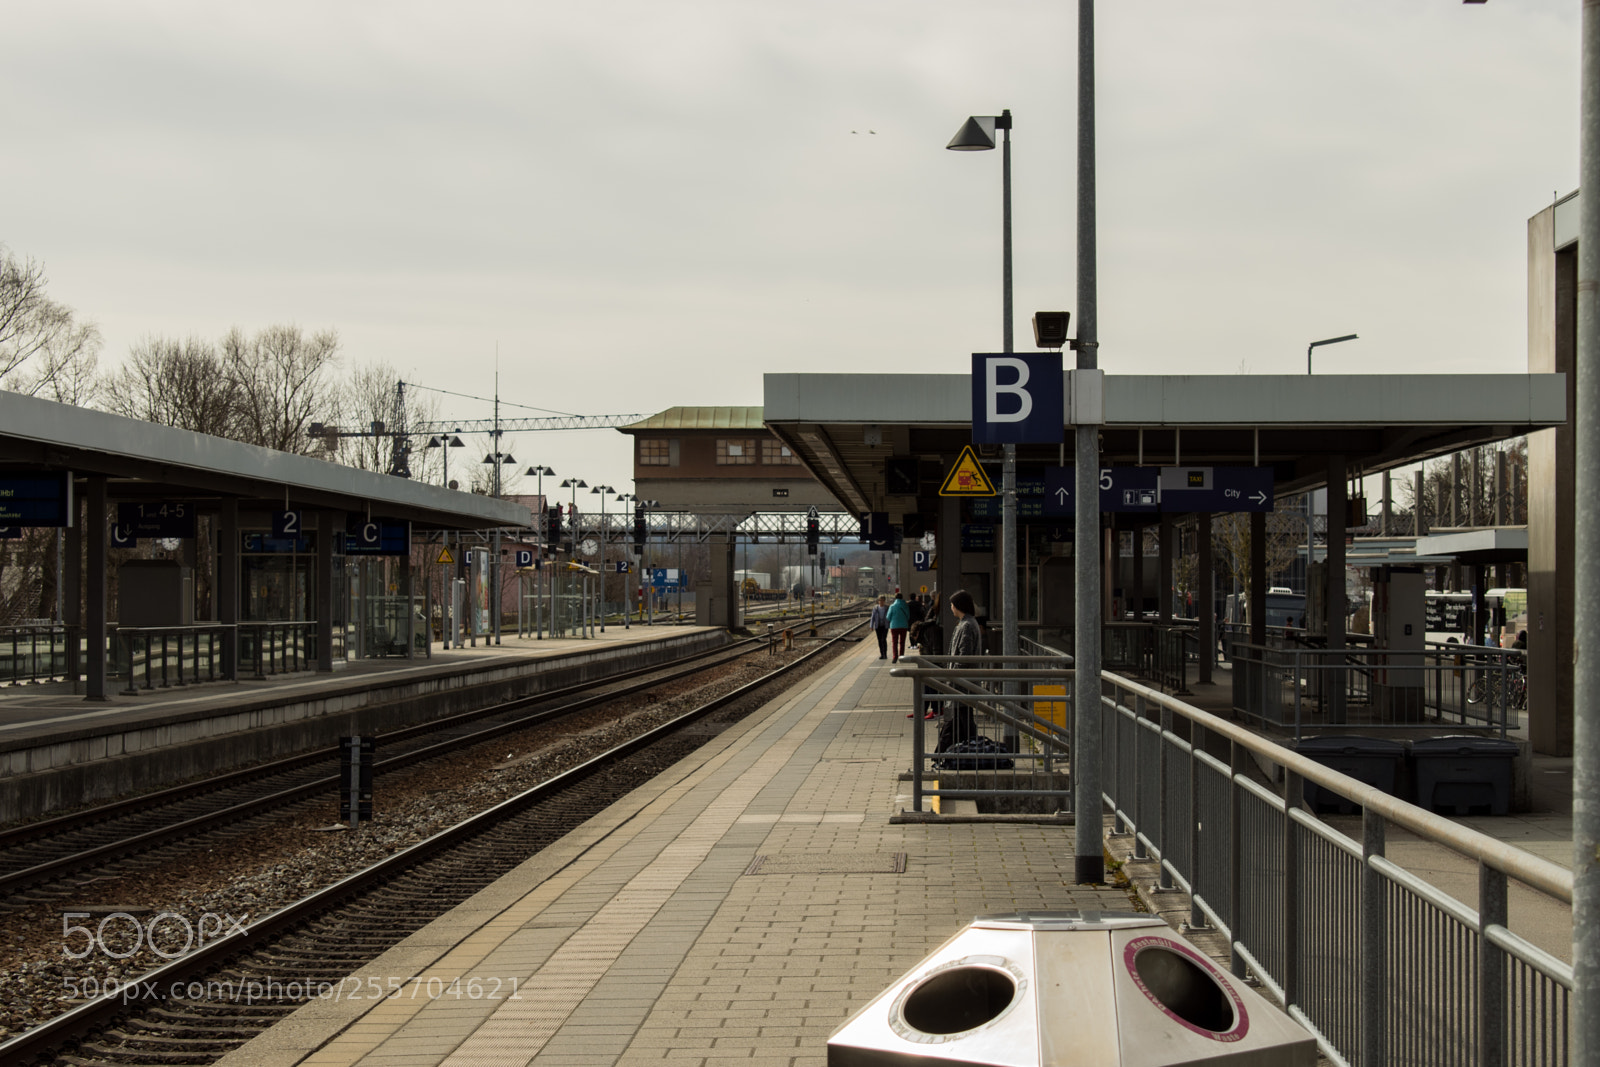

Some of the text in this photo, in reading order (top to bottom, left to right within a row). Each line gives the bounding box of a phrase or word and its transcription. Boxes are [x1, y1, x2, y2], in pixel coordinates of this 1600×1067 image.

[985, 357, 1033, 424] B
[1099, 469, 1113, 490] 5
[1189, 475, 1203, 483] TAXI
[1224, 488, 1241, 499] City
[137, 504, 144, 518] 1
[159, 503, 185, 519] 4-5
[283, 511, 298, 533] 2
[863, 513, 873, 535] 1
[363, 522, 378, 543] C
[520, 551, 531, 564] D
[914, 551, 925, 564] D
[621, 562, 628, 571] 2
[1130, 938, 1172, 950] Restmüll
[1211, 1032, 1240, 1042] Waste
